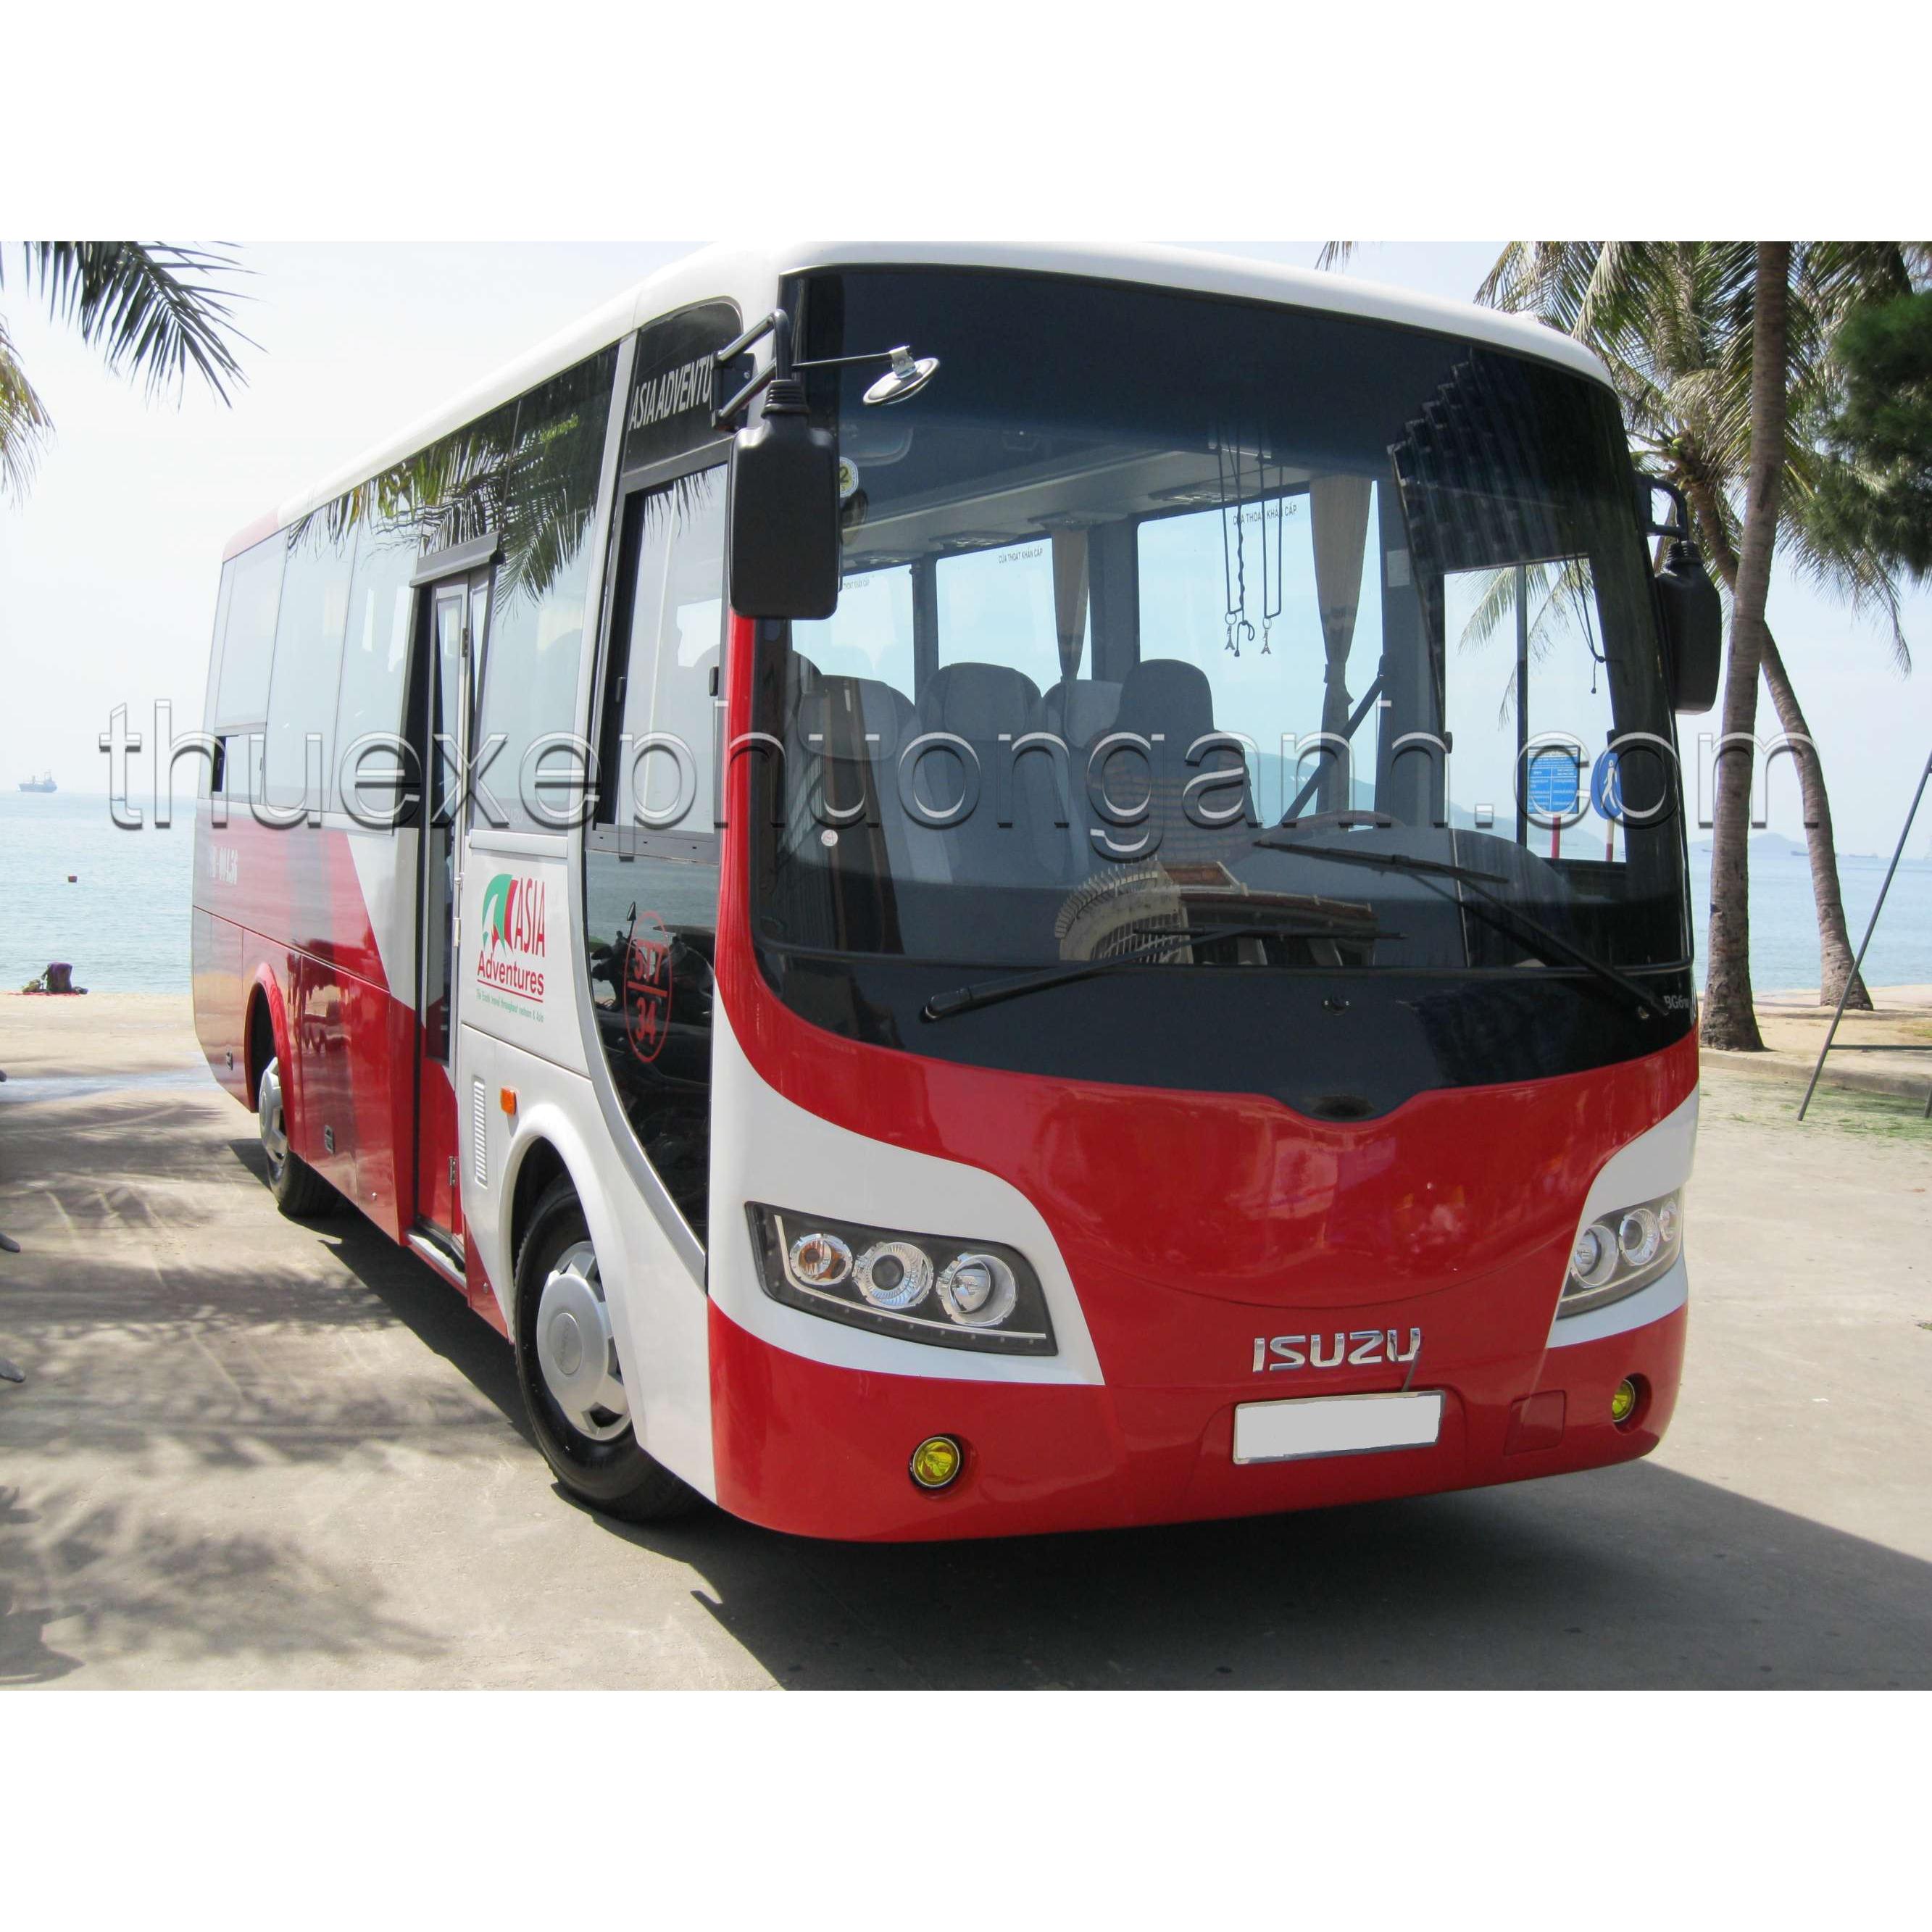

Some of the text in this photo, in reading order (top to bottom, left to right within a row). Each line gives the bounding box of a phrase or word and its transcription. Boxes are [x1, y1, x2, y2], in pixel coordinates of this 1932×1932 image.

[628, 378, 657, 431] ASIA
[513, 877, 545, 957] ASIA
[477, 950, 544, 996] Adventures
[1252, 1328, 1420, 1372] ISUZU
